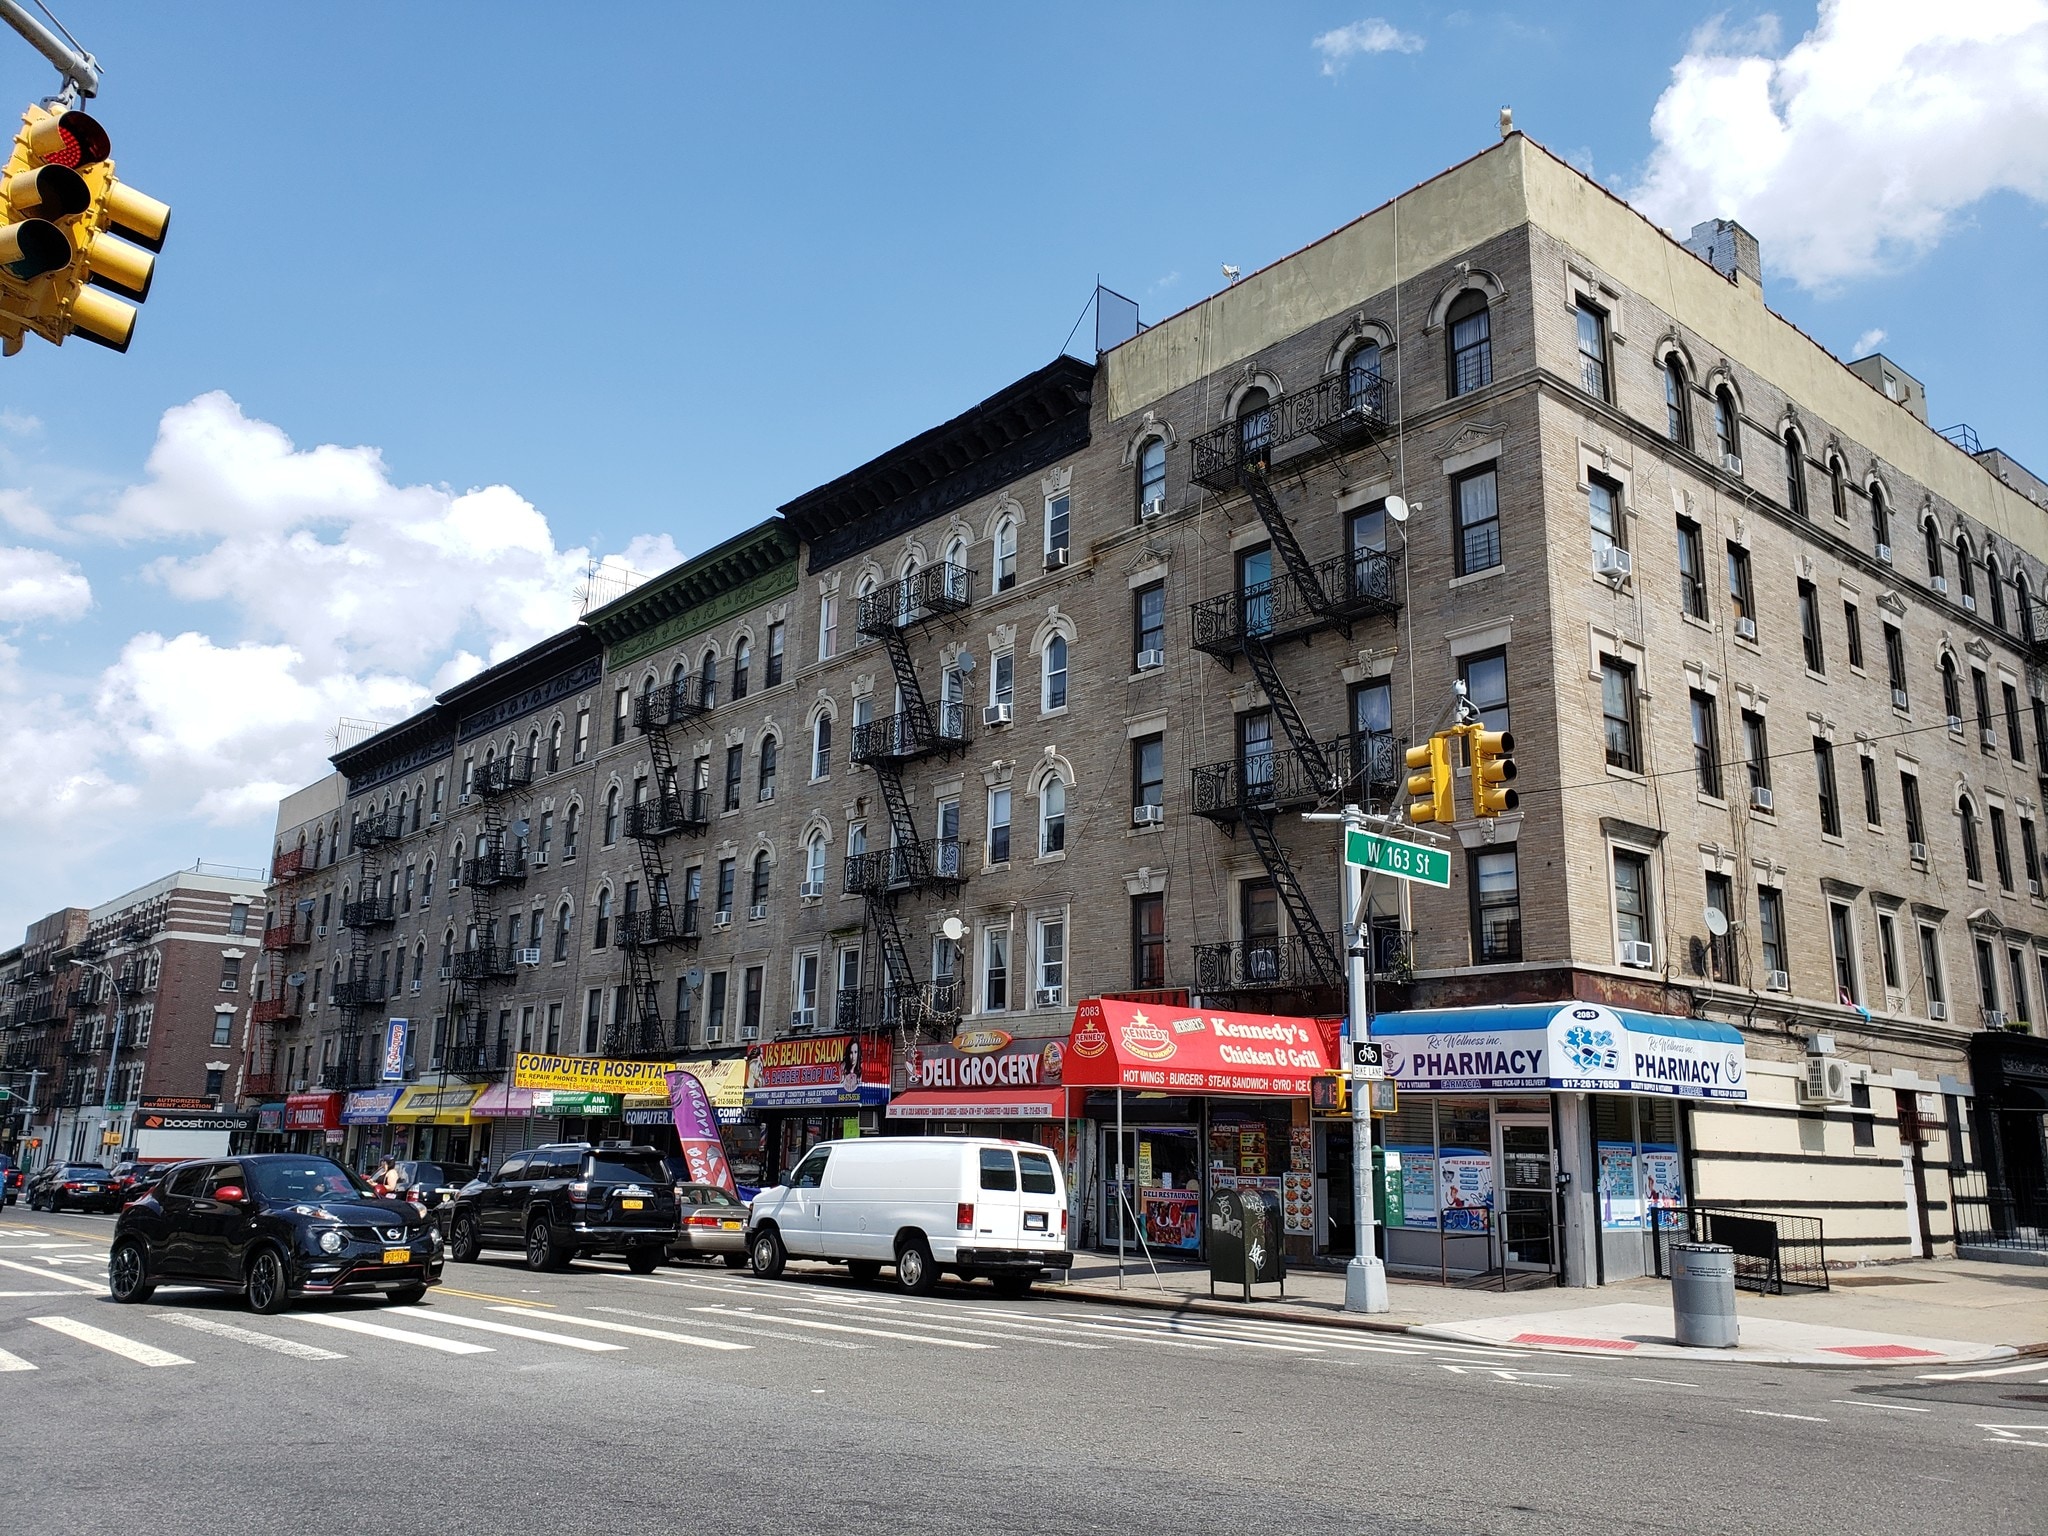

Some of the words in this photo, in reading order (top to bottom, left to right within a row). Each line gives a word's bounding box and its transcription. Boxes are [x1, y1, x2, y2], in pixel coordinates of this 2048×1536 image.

[1368, 841, 1380, 863] W
[1387, 846, 1410, 870] 163
[1416, 854, 1430, 875] St
[1081, 1006, 1100, 1016] 2083
[1076, 1033, 1104, 1041] KENNEDY
[1122, 1028, 1168, 1040] KENNEDY
[1210, 1018, 1309, 1044] Kennedy's
[1427, 1034, 1442, 1050] Rx
[1443, 1034, 1485, 1048] Wellness
[1658, 1038, 1684, 1054] Wellness
[763, 1044, 778, 1066] J&S
[780, 1041, 816, 1066] BEAUTY
[814, 1039, 844, 1062] SALON
[1220, 1044, 1276, 1066] Chicken
[1274, 1048, 1288, 1066] &
[1288, 1049, 1320, 1068] Grill
[520, 1056, 600, 1076] COMPUTER
[922, 1058, 956, 1086] DELI
[960, 1054, 1040, 1086] GROCERY
[1413, 1050, 1542, 1076] PHARMACY
[1635, 1053, 1720, 1084] PHARMACY
[772, 1070, 800, 1084] BARBER
[802, 1068, 822, 1082] SHOP
[823, 1066, 839, 1081] INC.
[1356, 1066, 1366, 1076] BIKE
[1368, 1066, 1382, 1076] LANE
[1124, 1070, 1139, 1082] HOT
[1140, 1070, 1164, 1084] WINGS
[1170, 1073, 1203, 1086] BURGERS
[1208, 1074, 1231, 1088] STEAK
[1232, 1076, 1268, 1090] SANDWICH
[1272, 1079, 1292, 1091] GYRO
[1295, 1080, 1306, 1091] ICE
[1441, 1079, 1482, 1088] FARMACIA
[1562, 1079, 1620, 1088] 917-261-7650
[592, 1096, 606, 1104] ANA
[295, 1109, 323, 1124] PHARMACY
[583, 1105, 613, 1114] VARIETY
[626, 1110, 668, 1124] COMPUTER
[164, 1117, 248, 1129] boostmobile
[1159, 1191, 1199, 1200] RESTAURANT
